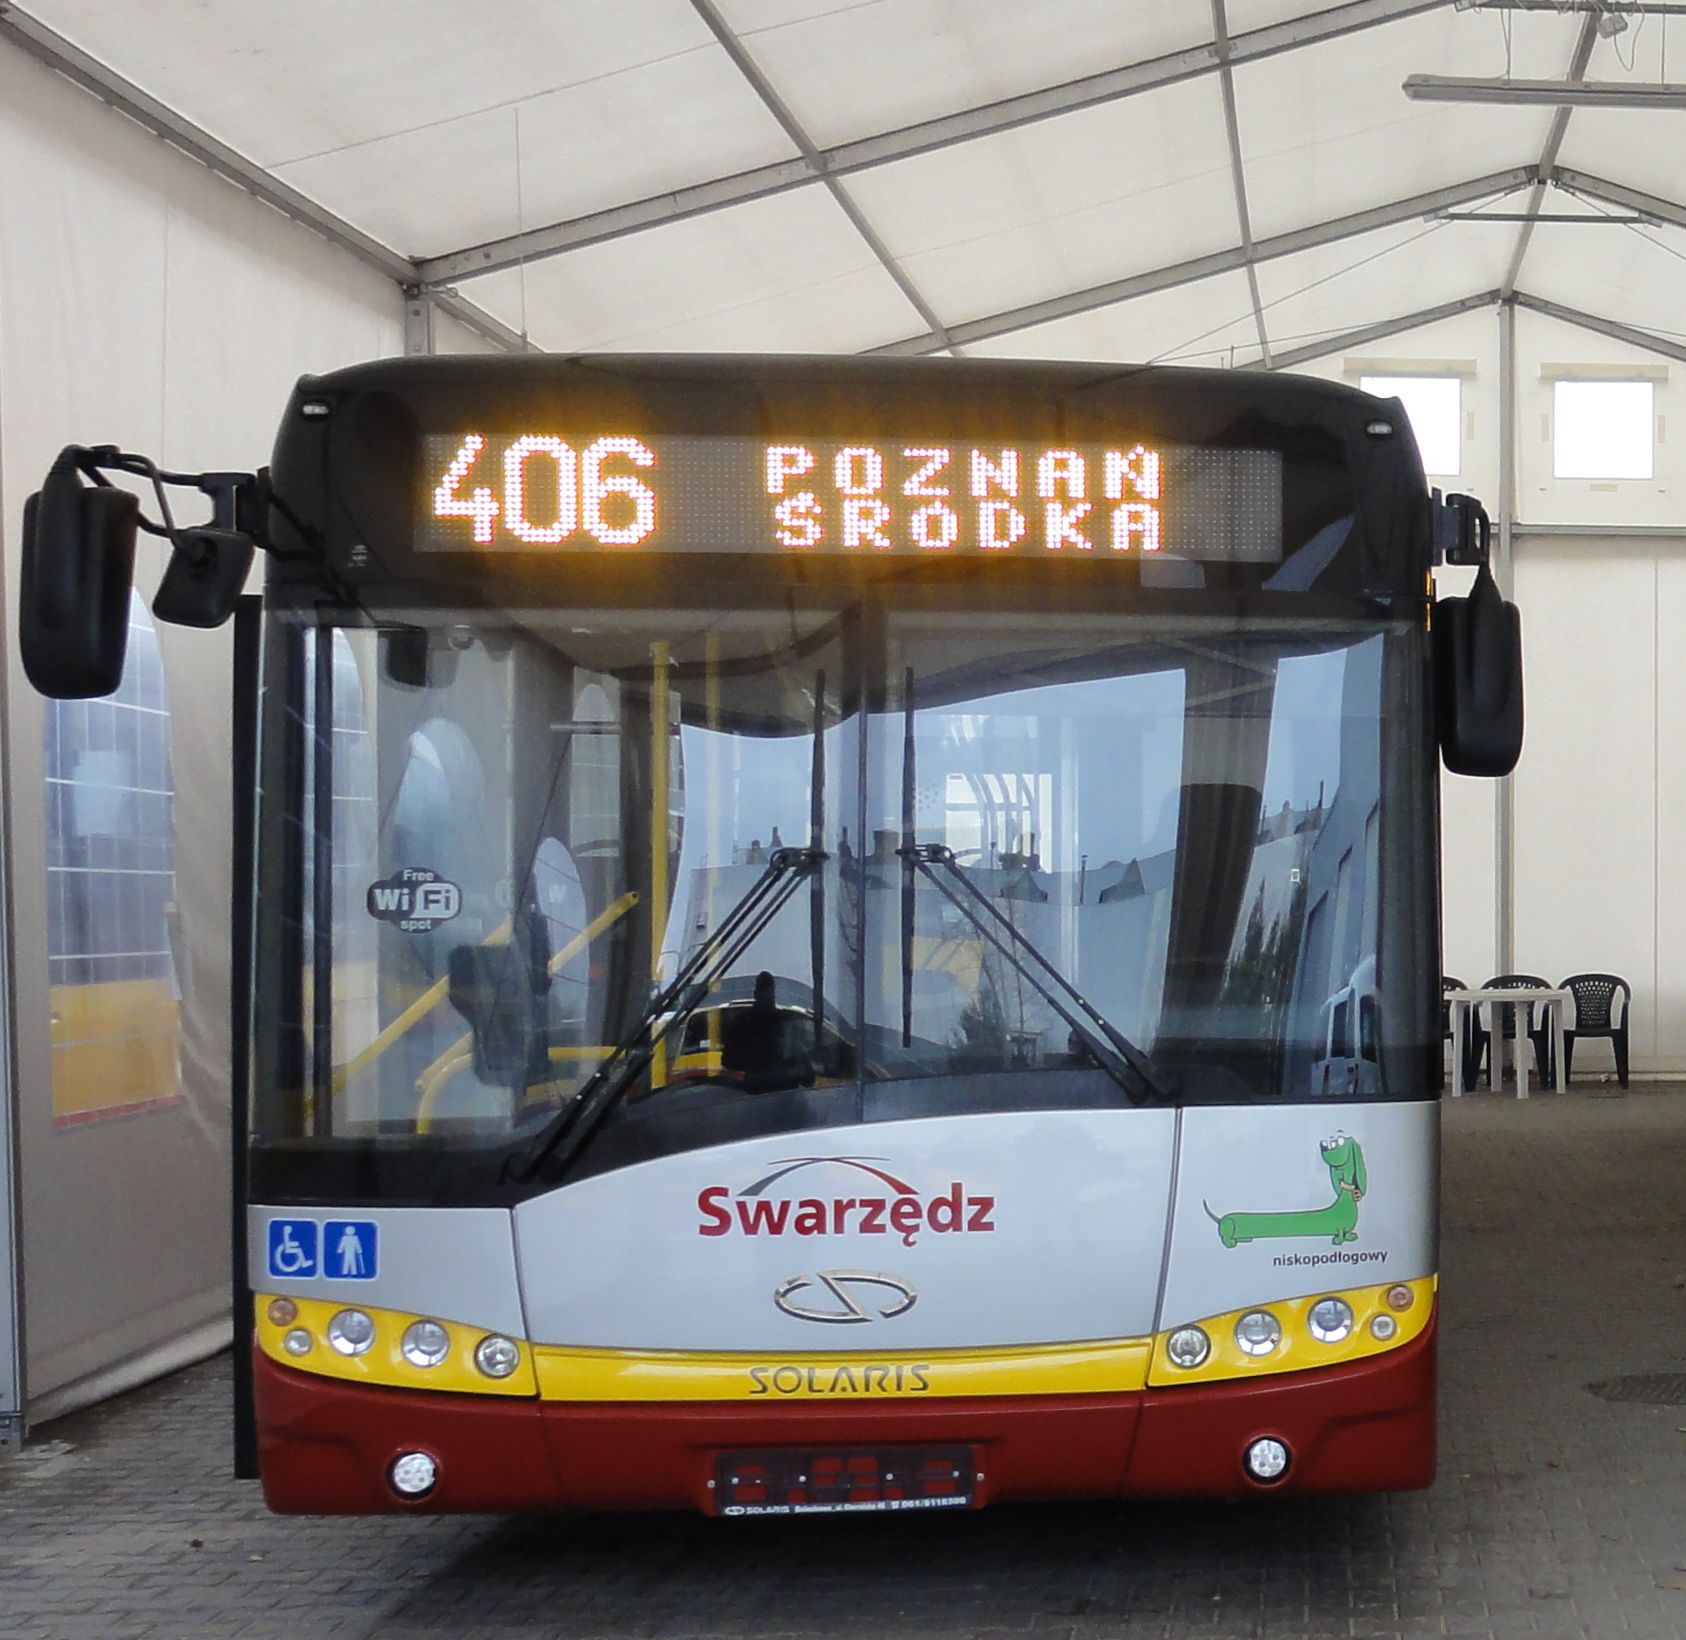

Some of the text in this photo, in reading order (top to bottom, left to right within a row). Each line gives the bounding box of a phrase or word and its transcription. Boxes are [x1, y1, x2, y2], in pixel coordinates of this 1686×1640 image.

[765, 444, 1161, 499] POZNAŃ
[434, 434, 656, 545] 406
[402, 868, 435, 882] Free
[400, 918, 433, 932] spot
[697, 1181, 996, 1248] Swarzędz
[1272, 1250, 1389, 1268] niskopodłogowy
[748, 1364, 931, 1395] SOLARIS
[745, 1505, 790, 1515] SOLARIS
